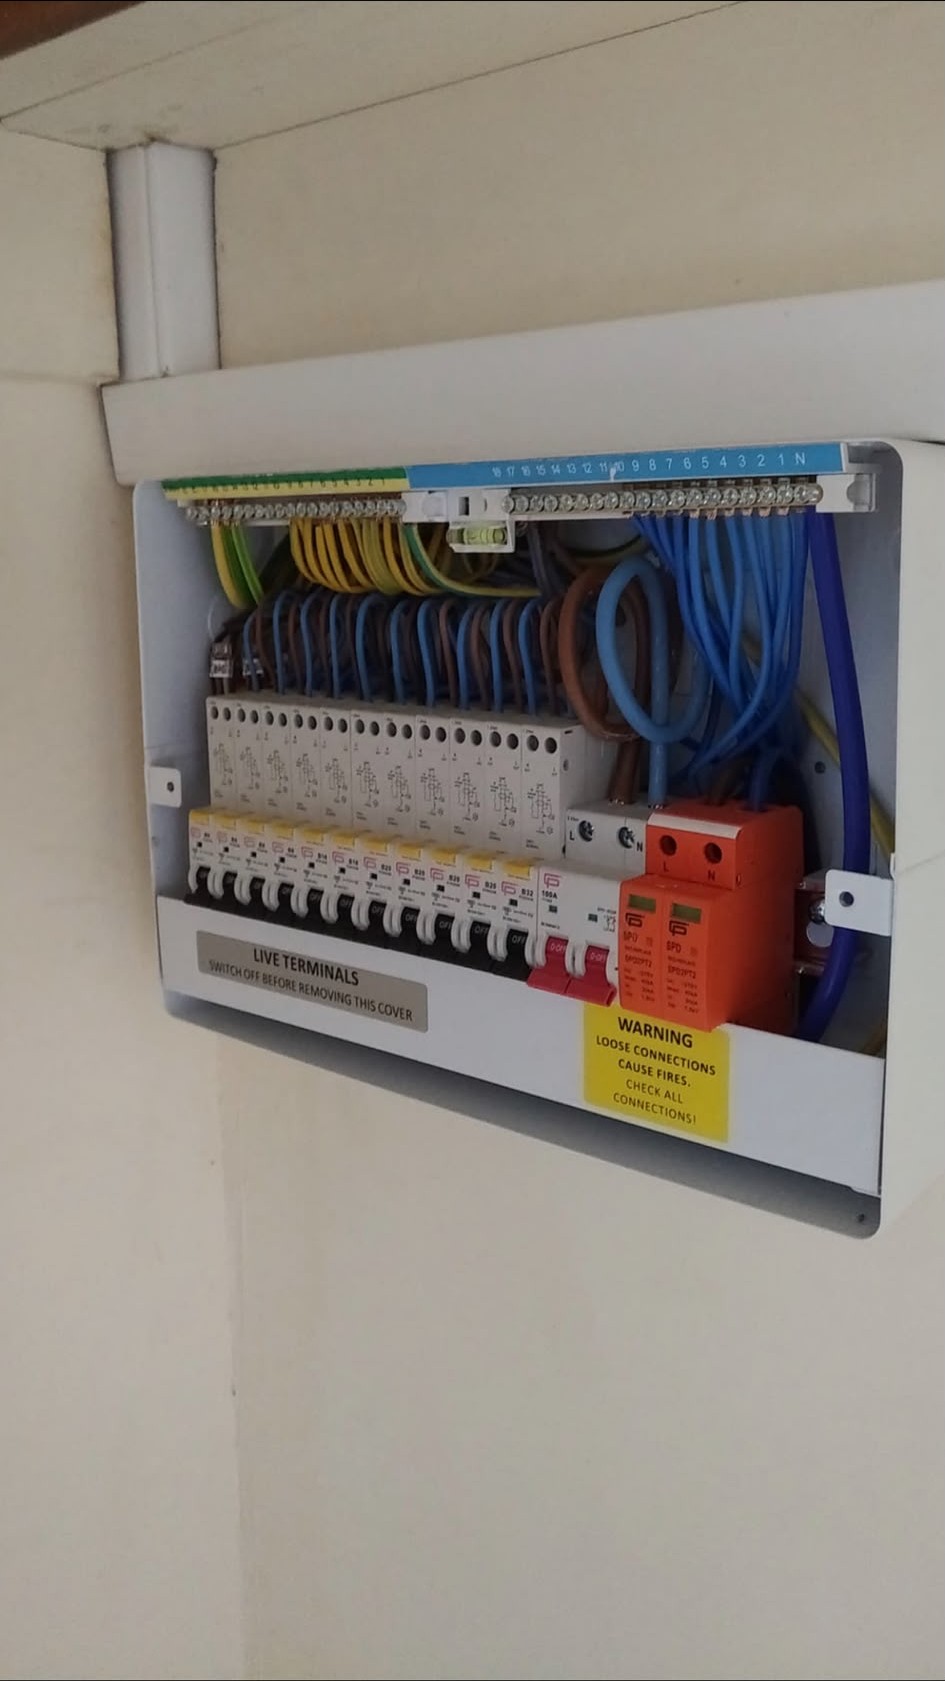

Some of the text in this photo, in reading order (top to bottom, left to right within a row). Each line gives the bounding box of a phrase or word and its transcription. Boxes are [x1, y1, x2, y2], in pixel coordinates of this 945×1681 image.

[566, 463, 577, 474] 13
[582, 463, 592, 474] 12
[631, 459, 640, 472] 9
[649, 459, 657, 471] 8
[666, 458, 673, 470] 7
[683, 457, 691, 470] 6
[701, 456, 709, 469] 5
[719, 455, 727, 468] 4
[738, 454, 746, 467] 3
[757, 454, 766, 467] 2
[777, 453, 784, 466] 1
[795, 452, 806, 466] N
[569, 831, 575, 841] L
[636, 842, 643, 852] N
[663, 861, 715, 881] L N
[667, 940, 682, 953] SPD
[253, 948, 359, 986] LIVE TERMINALS
[208, 960, 413, 1022] SWITCH OFF BEFORE REMOVING THIS COVER
[618, 1016, 693, 1049] WARNING
[596, 1035, 716, 1076] LOOSE CONNECTIONS
[618, 1058, 691, 1087] CAUSE FIRES.
[626, 1079, 683, 1104] CHECK ALL
[613, 1092, 697, 1124] CONNECTIONS!
